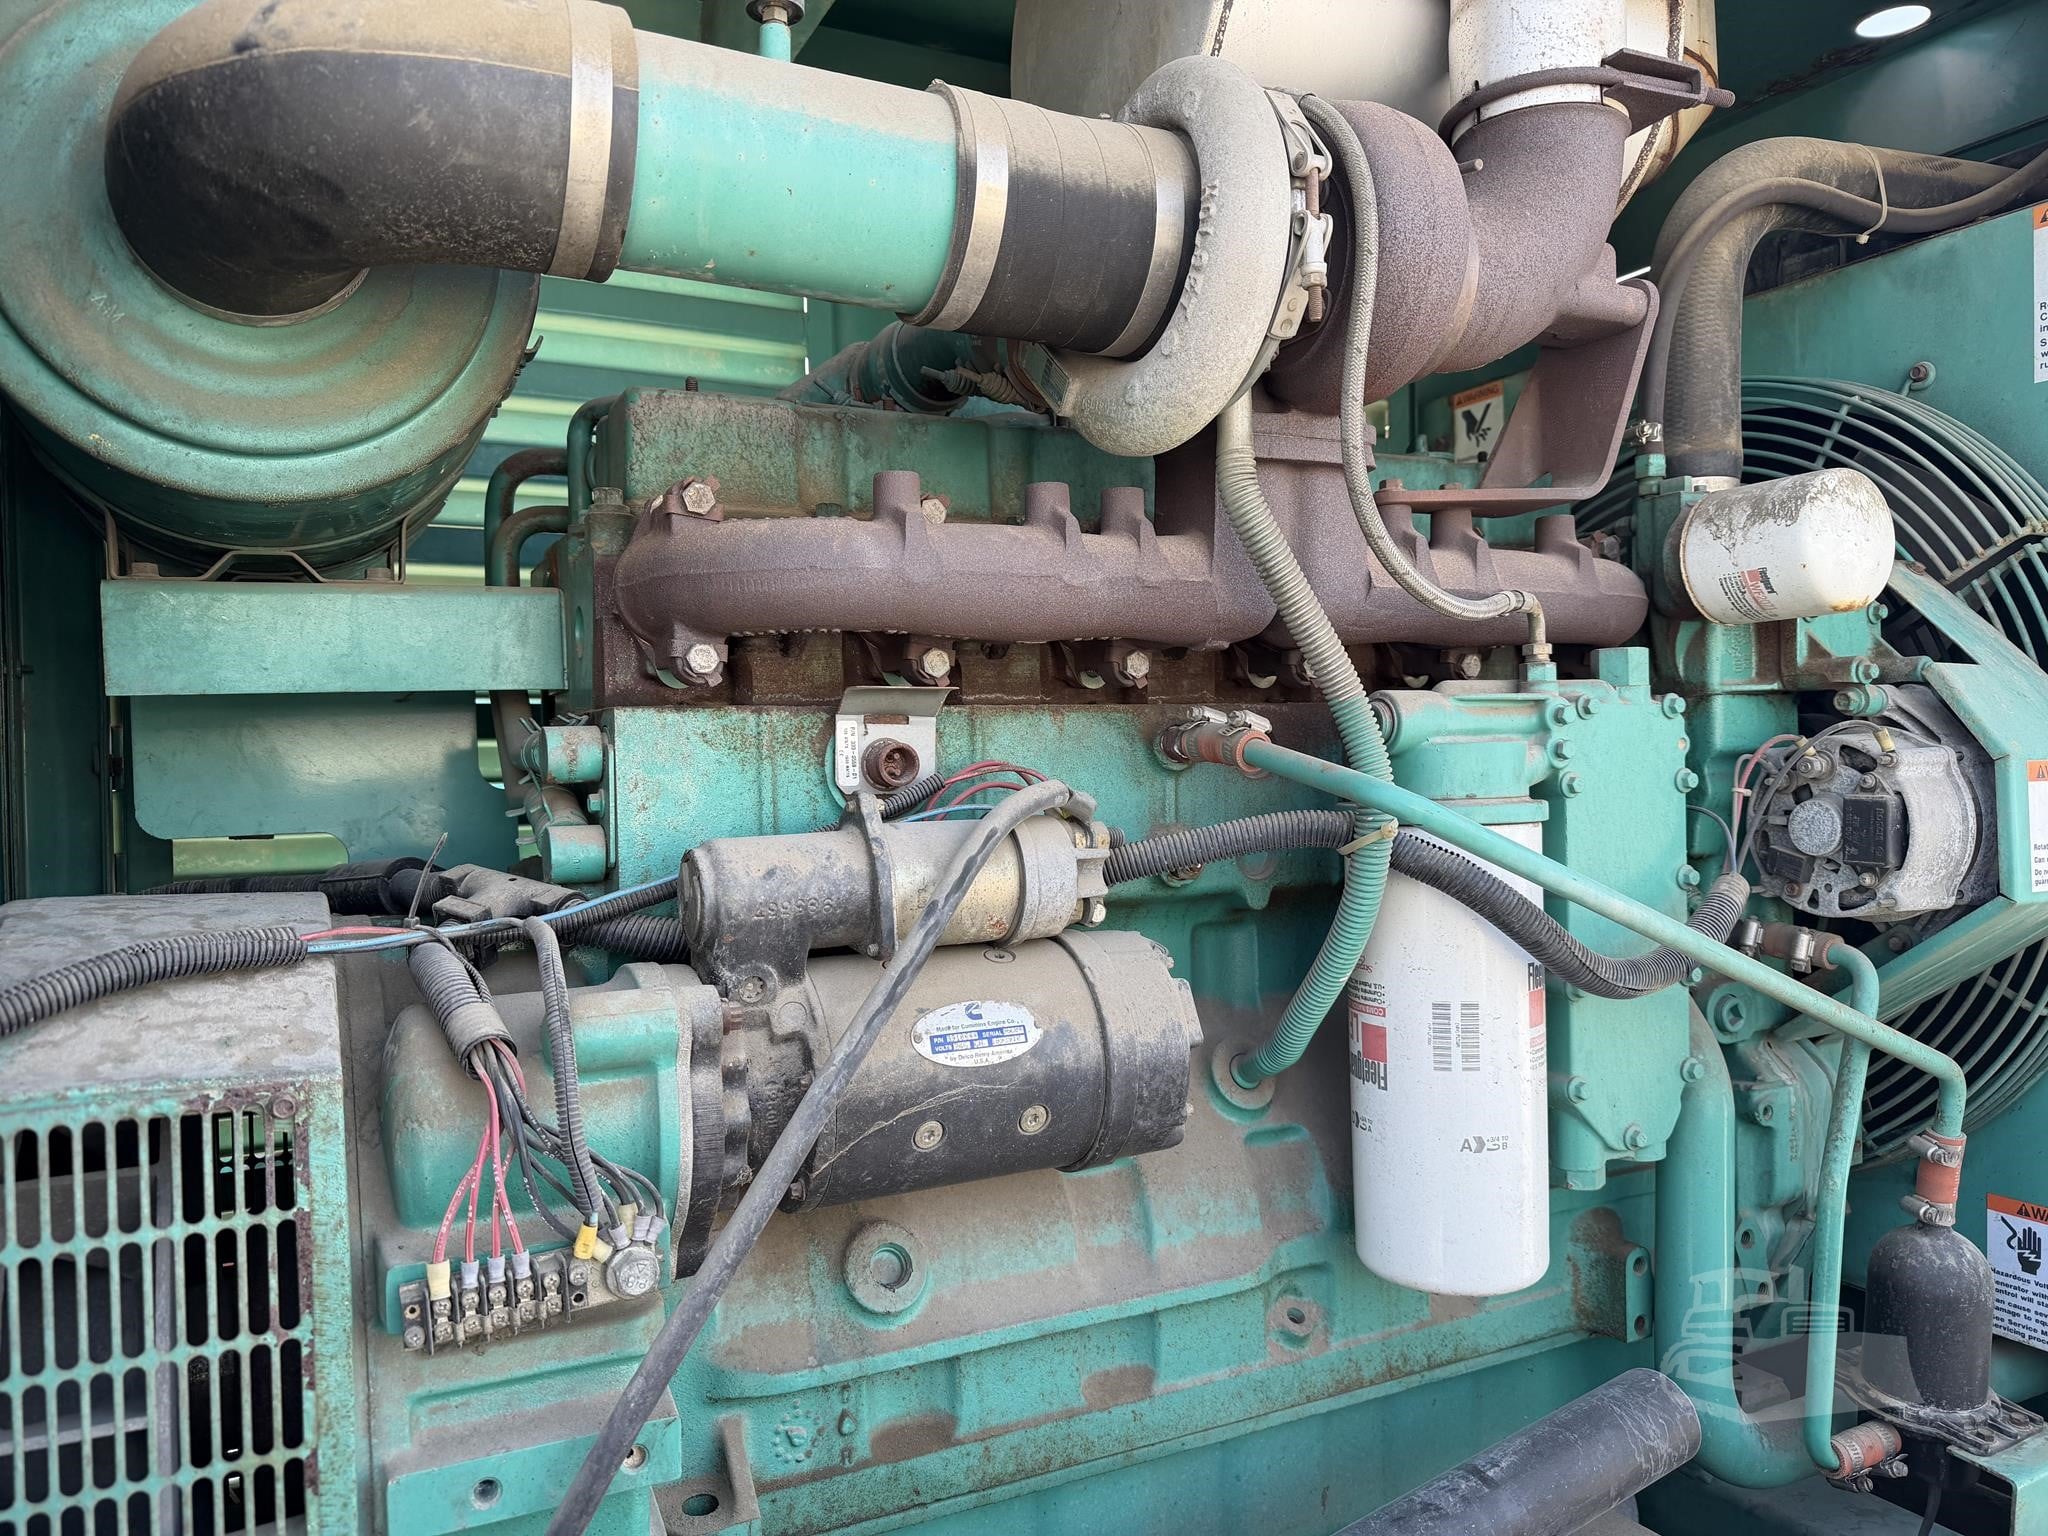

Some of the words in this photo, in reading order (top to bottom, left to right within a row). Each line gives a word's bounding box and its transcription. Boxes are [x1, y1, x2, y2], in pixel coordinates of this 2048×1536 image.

[2031, 1206, 2048, 1221] W
[1994, 1279, 2029, 1294] enerator
[1994, 1287, 2018, 1299] ontrol
[2020, 1295, 2034, 1304] will
[1994, 1305, 2021, 1318] amage
[2008, 1301, 2031, 1313] cause
[1992, 1322, 2025, 1338] ervicing
[1993, 1315, 2005, 1323] ee
[2007, 1318, 2038, 1333] Service
